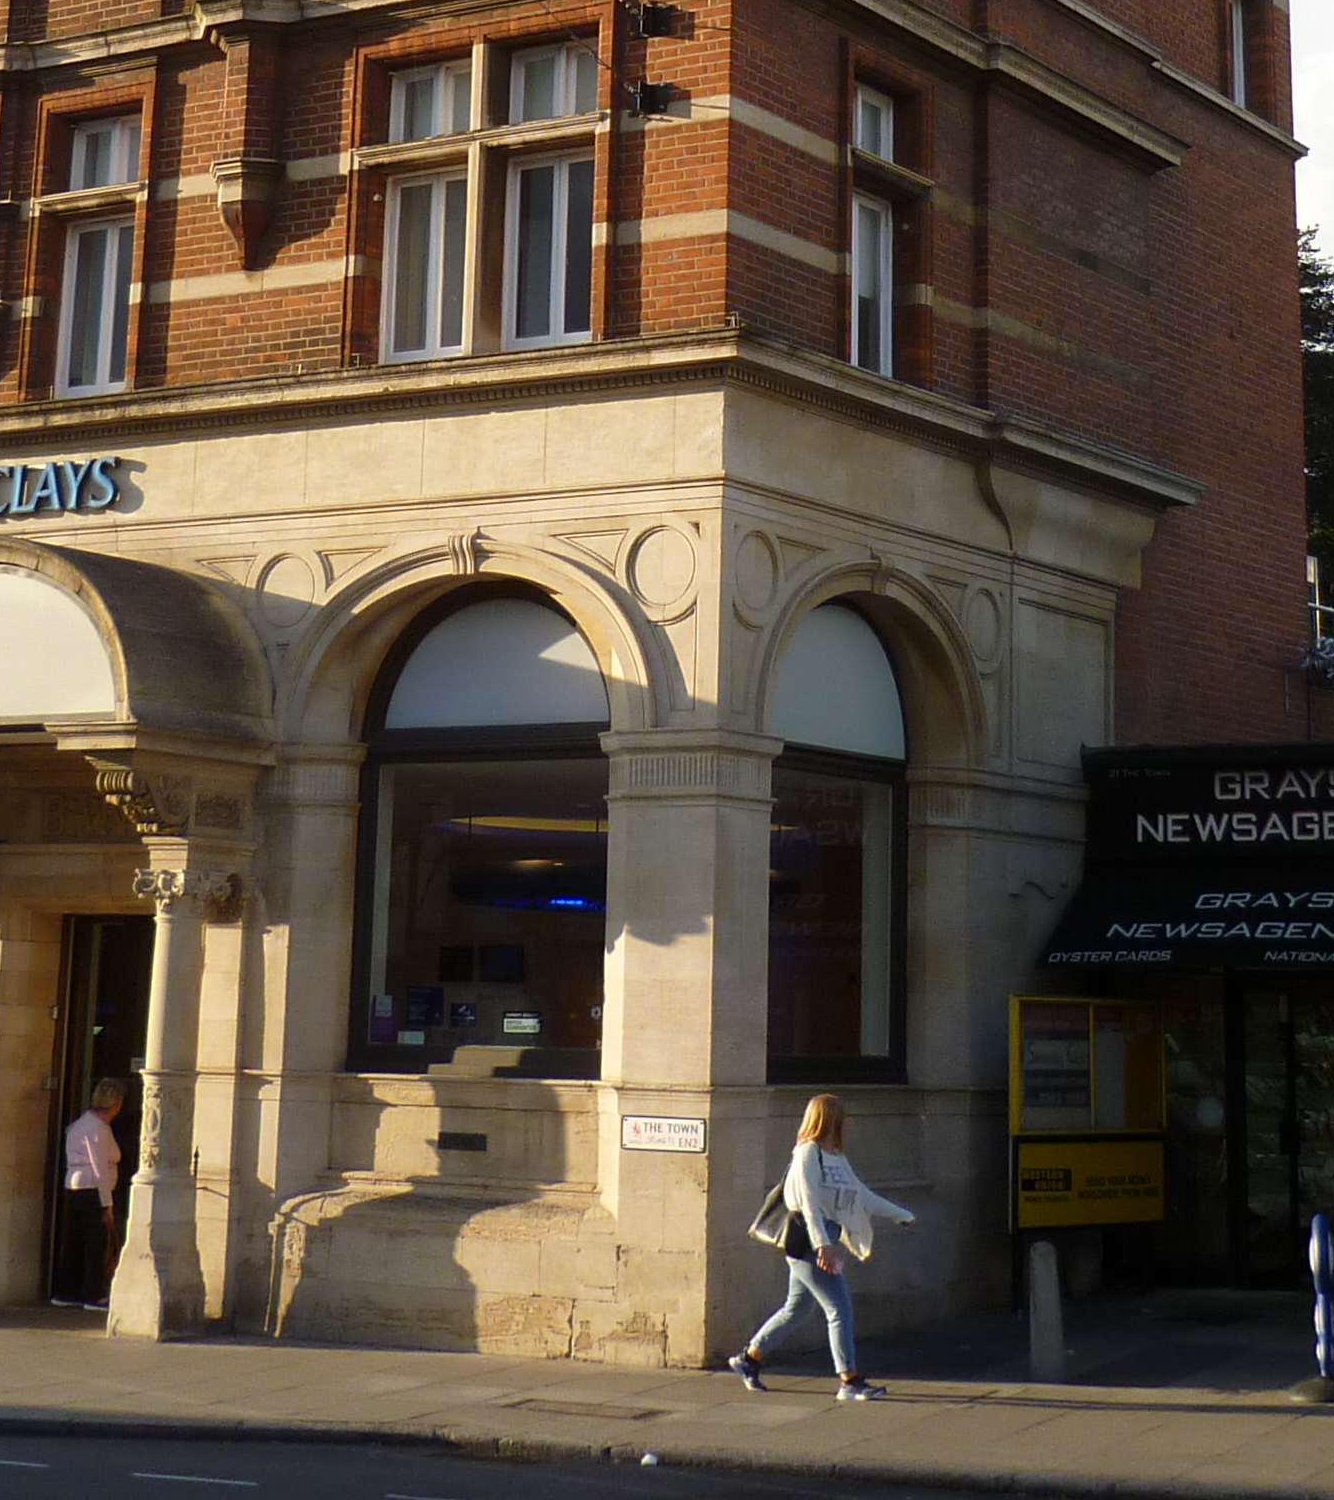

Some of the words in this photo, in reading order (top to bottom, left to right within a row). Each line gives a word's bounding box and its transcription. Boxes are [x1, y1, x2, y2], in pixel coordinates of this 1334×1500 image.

[1048, 951, 1112, 964] OYSTER
[1114, 950, 1172, 962] CARDS
[643, 1122, 663, 1133] THE
[667, 1123, 699, 1135] TOWN
[678, 1137, 698, 1148] EN2
